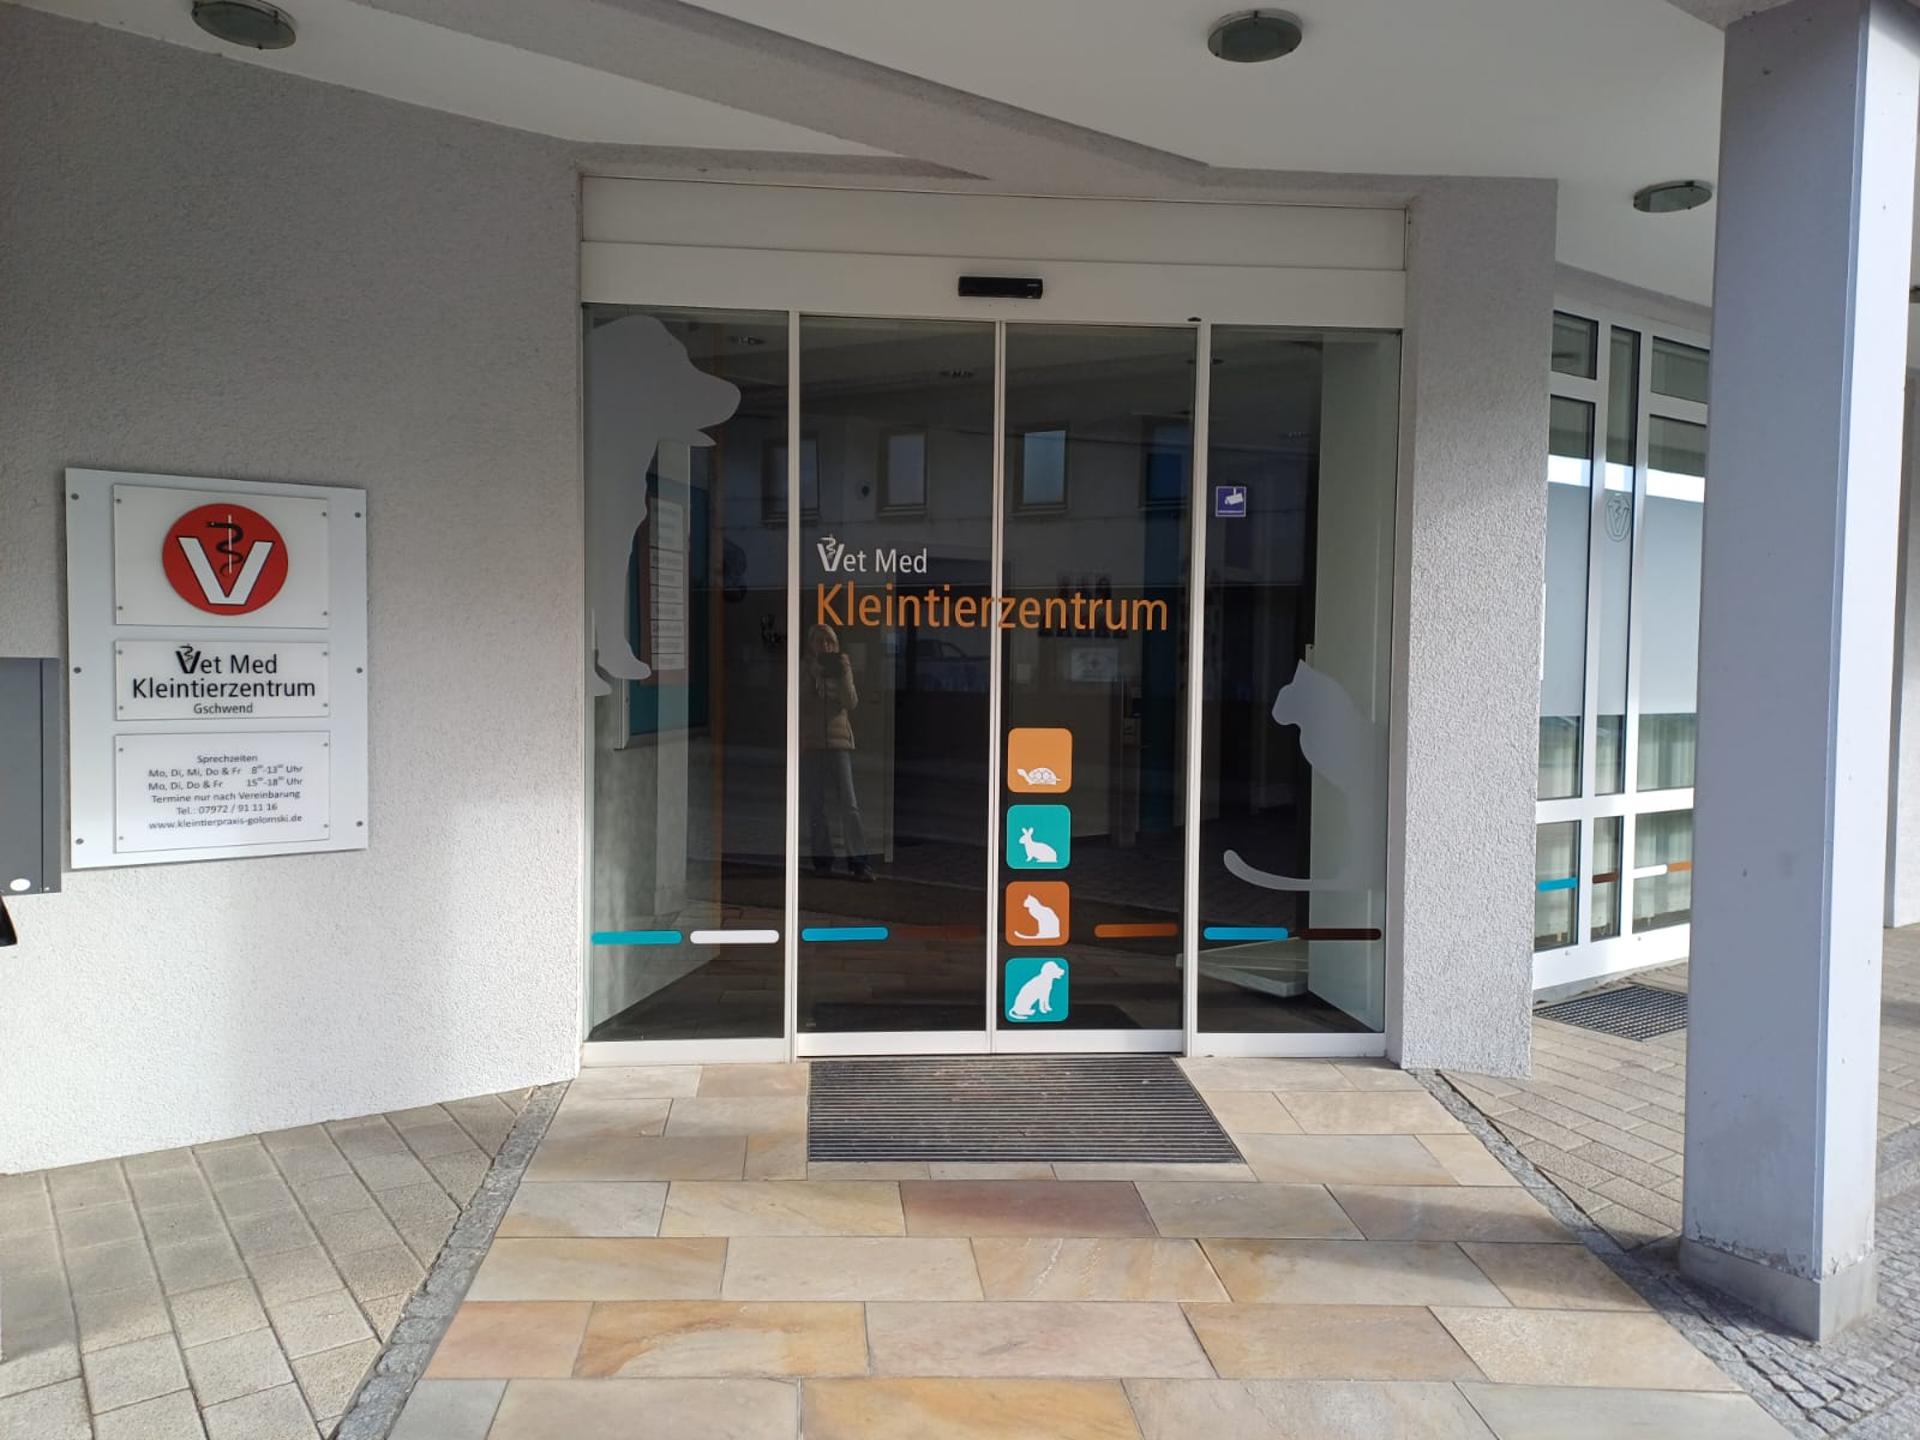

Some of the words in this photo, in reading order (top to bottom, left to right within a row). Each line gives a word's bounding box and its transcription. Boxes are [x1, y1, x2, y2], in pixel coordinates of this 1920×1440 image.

[817, 534, 867, 573] Vet
[875, 547, 928, 574] Med
[177, 536, 275, 606] V
[816, 580, 1168, 632] Kleintierzentrum
[174, 645, 222, 675] Vet
[230, 653, 278, 675] Med
[132, 678, 316, 699] Kleintierzentrum
[193, 703, 254, 715] Gschwend
[196, 754, 258, 765] Sprechzeiten
[205, 767, 219, 776] Do
[221, 766, 230, 776] &
[231, 766, 241, 775] Fr
[286, 764, 303, 773] Uhr
[186, 780, 200, 790] Do
[202, 780, 211, 789] &
[213, 779, 223, 788] Fr
[286, 777, 303, 786] Uhr
[151, 794, 192, 804] Termine
[193, 793, 211, 801] nur
[212, 791, 236, 801] nach
[238, 790, 301, 801] Vereinbarung
[198, 804, 229, 815] 07972
[238, 803, 249, 812] 91
[252, 803, 263, 812] 11
[266, 802, 279, 812] 16
